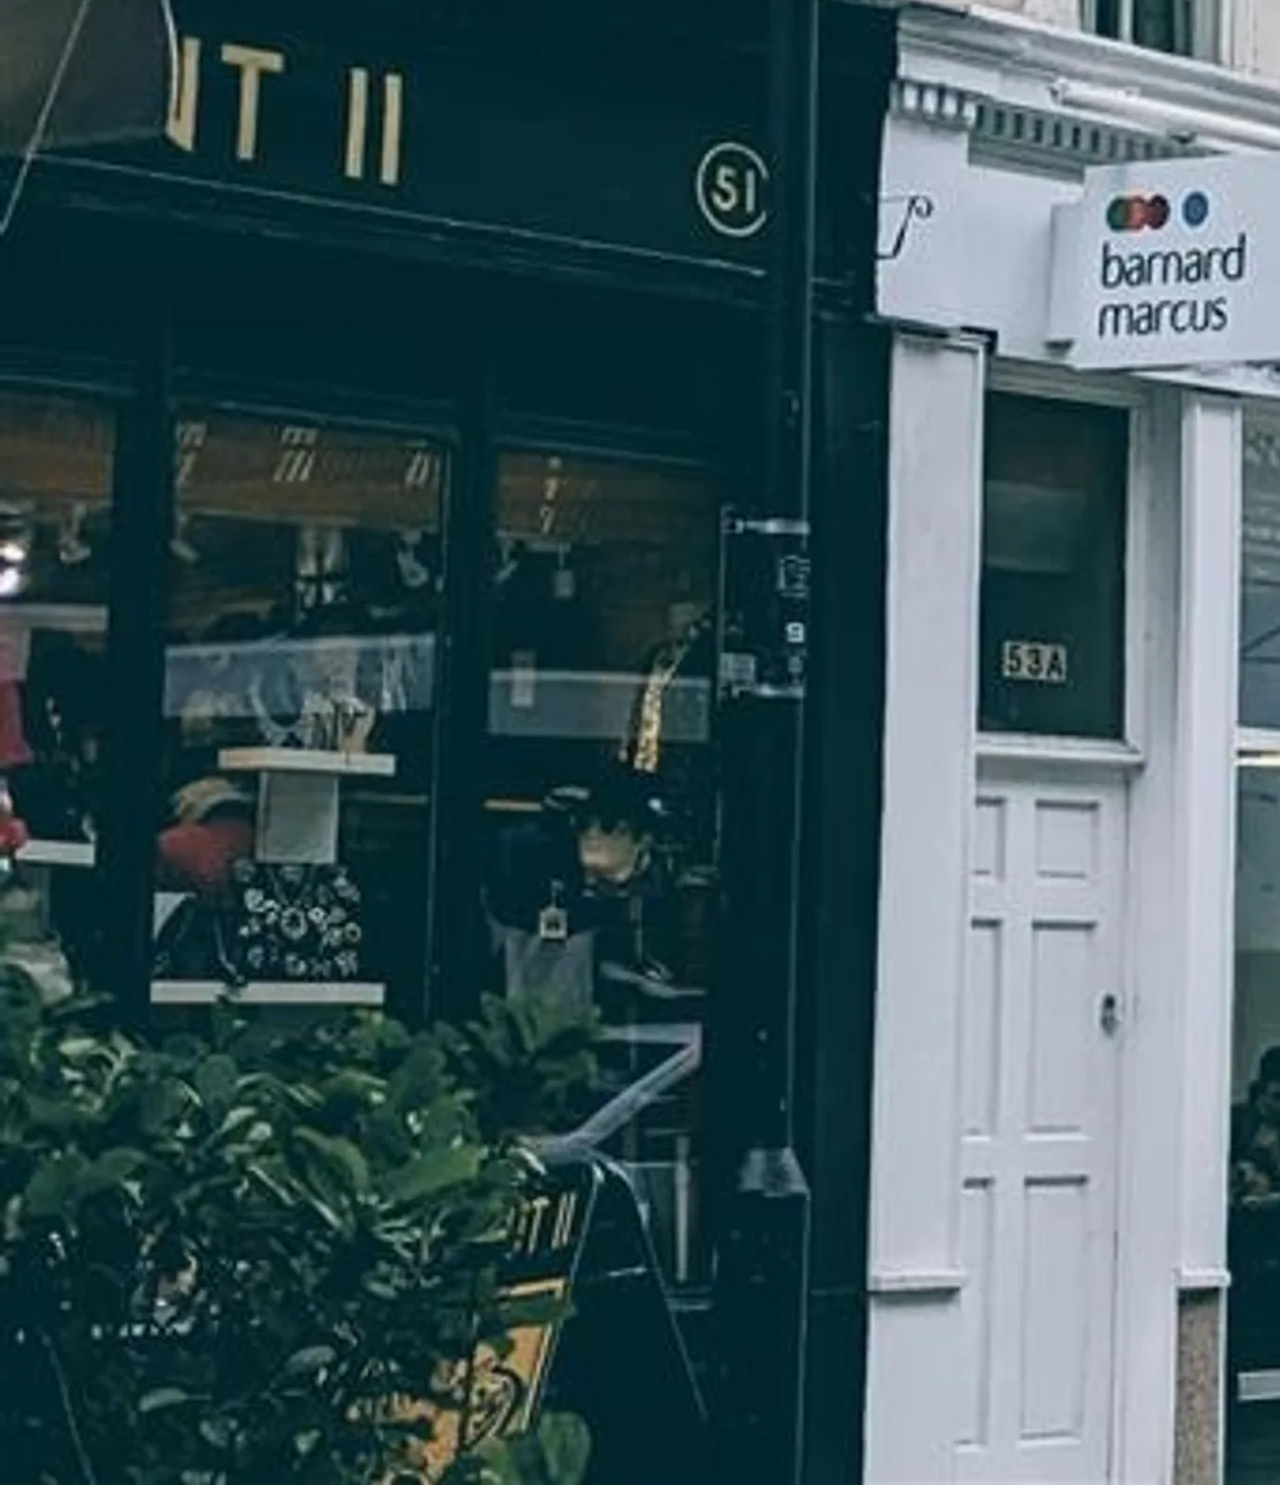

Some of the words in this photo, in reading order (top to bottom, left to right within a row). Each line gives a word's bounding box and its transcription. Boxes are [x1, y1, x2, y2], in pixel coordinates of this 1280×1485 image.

[711, 165, 756, 214] 51
[1101, 231, 1247, 290] barnard
[1098, 295, 1228, 339] marcus
[1008, 643, 1064, 679] 53A
